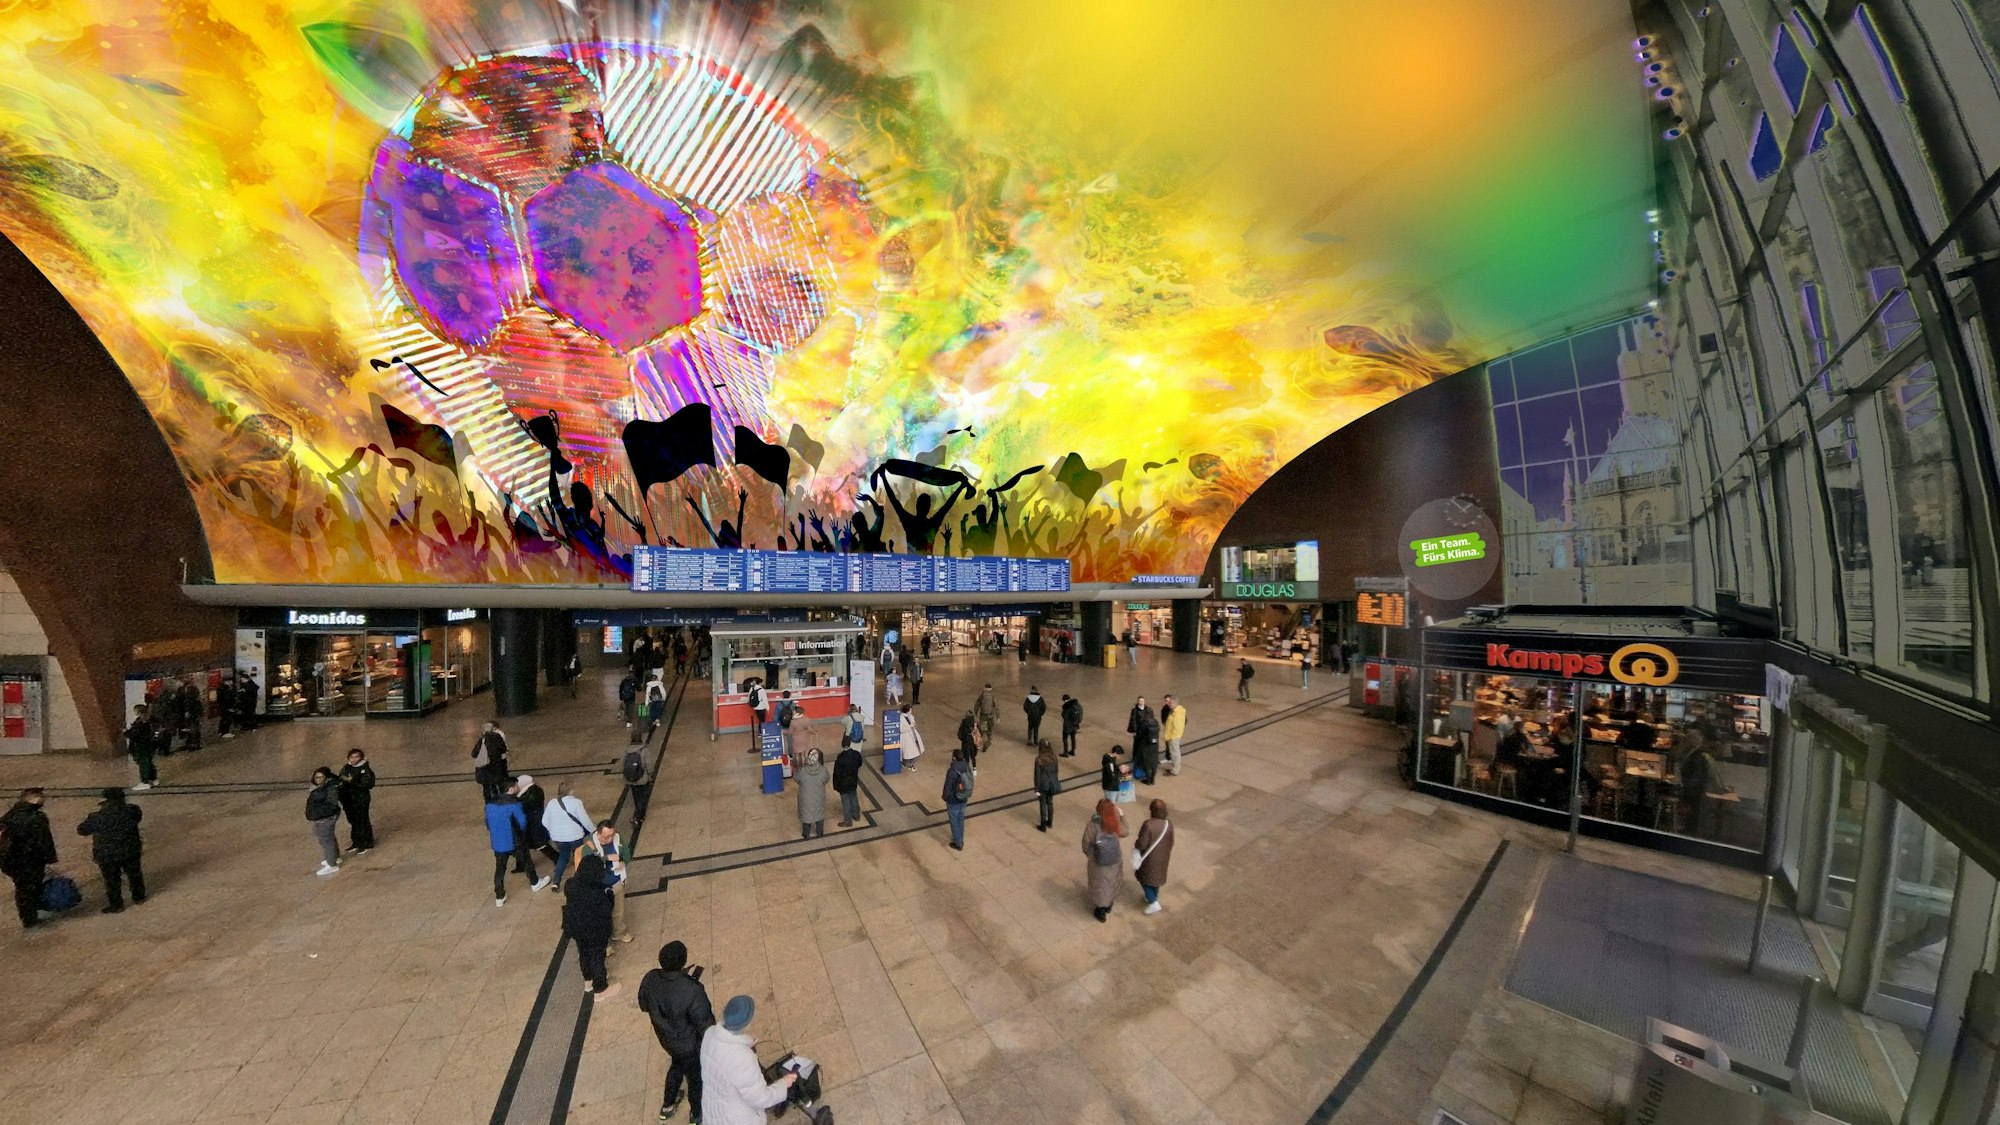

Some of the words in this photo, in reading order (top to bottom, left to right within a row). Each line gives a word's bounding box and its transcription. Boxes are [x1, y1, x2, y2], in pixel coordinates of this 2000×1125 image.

[1421, 542, 1438, 552] Ein
[1440, 538, 1471, 549] Team.
[1423, 552, 1445, 563] Fürs
[1447, 549, 1480, 559] Klima.
[1138, 575, 1175, 583] STARBUCKS
[1176, 575, 1196, 583] COFFEE
[1236, 584, 1295, 597] DOUGLAS
[288, 610, 366, 625] Leonidas
[447, 607, 477, 622] Leonidas
[798, 640, 847, 650] Information
[1486, 643, 1605, 679] Kamps
